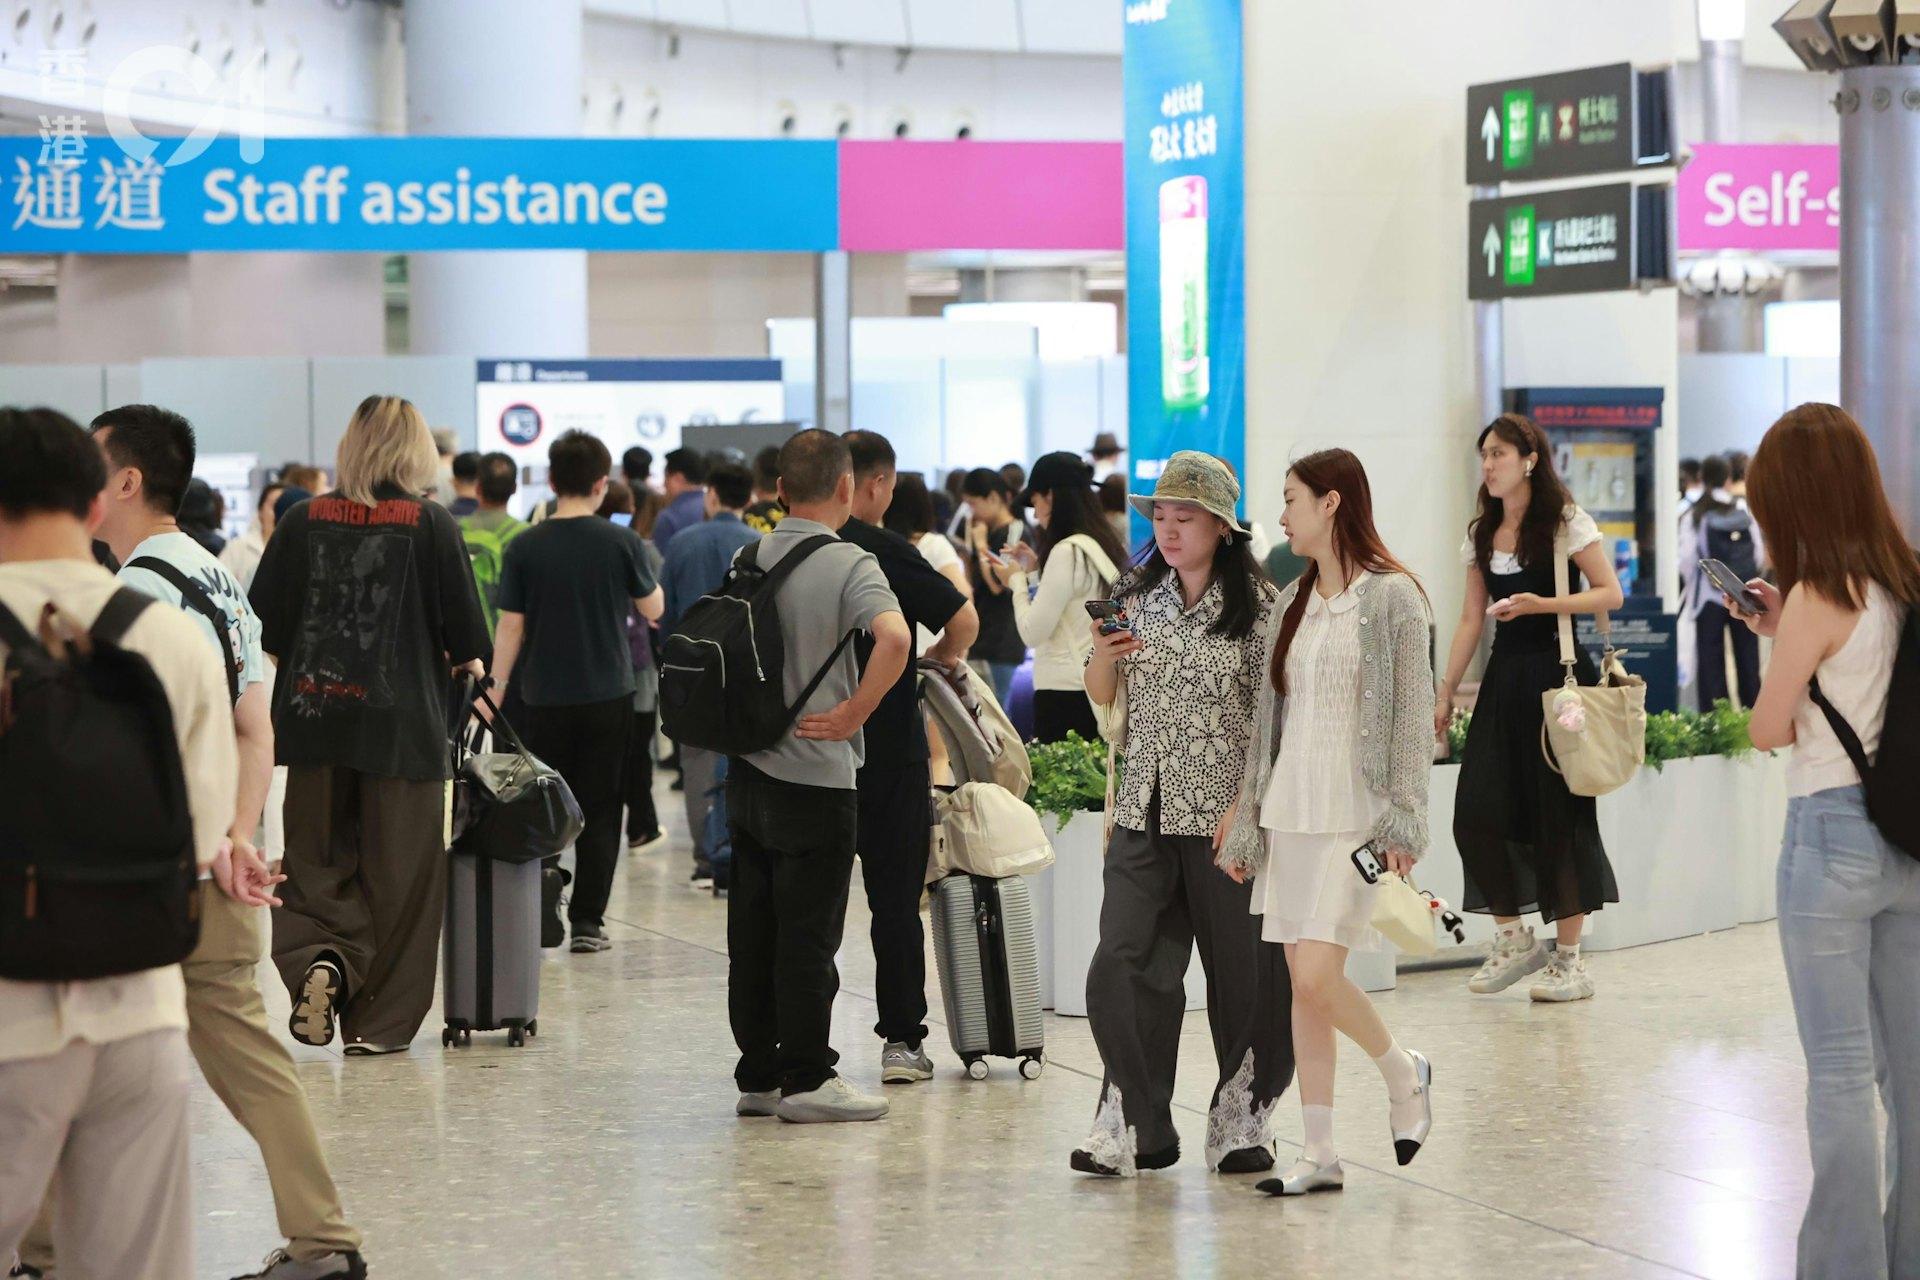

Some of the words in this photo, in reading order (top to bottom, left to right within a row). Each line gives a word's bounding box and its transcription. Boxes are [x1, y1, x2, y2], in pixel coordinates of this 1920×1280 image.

[0, 155, 166, 231] 通道
[203, 165, 349, 225] Staff
[360, 168, 668, 226] assistance
[1538, 229, 1551, 260] K
[368, 498, 422, 527] ARCHIVE
